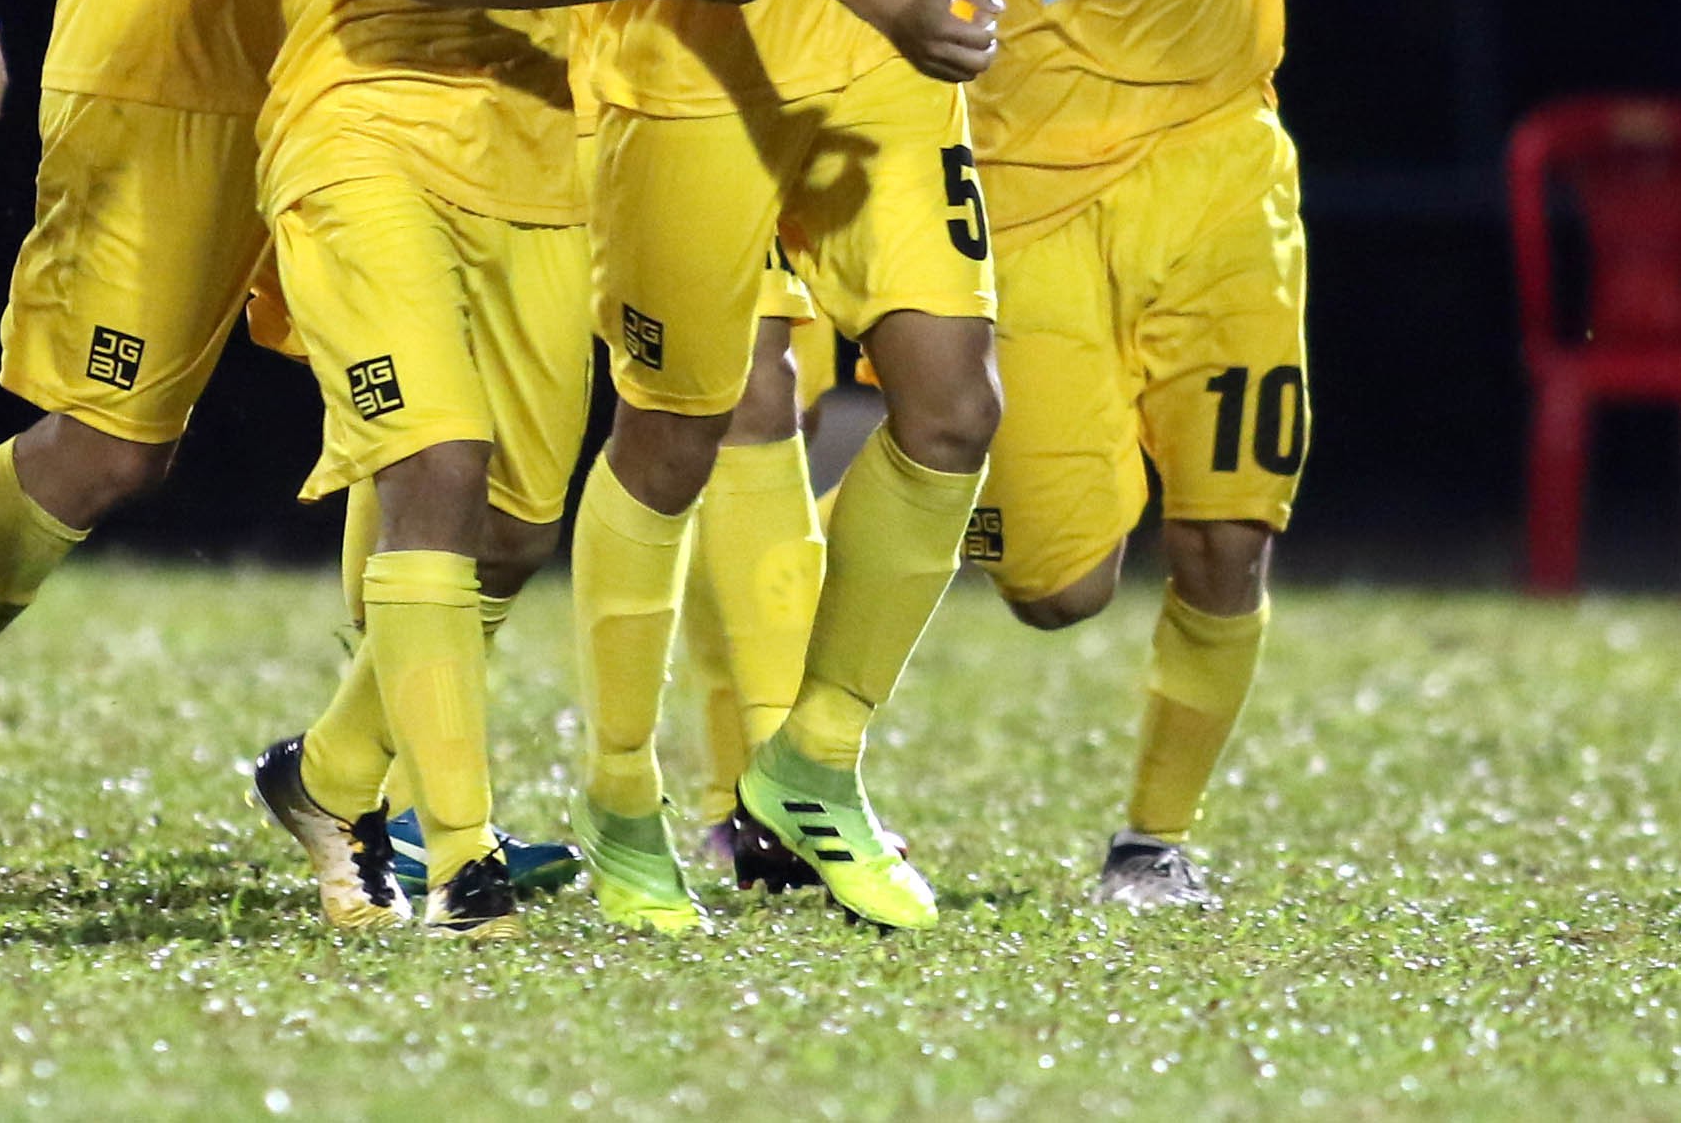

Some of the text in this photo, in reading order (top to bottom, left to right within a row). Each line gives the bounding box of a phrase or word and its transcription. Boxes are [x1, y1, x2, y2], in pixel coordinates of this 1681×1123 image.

[940, 144, 988, 261] 5
[93, 332, 141, 363] JG
[1205, 365, 1304, 476] 10
